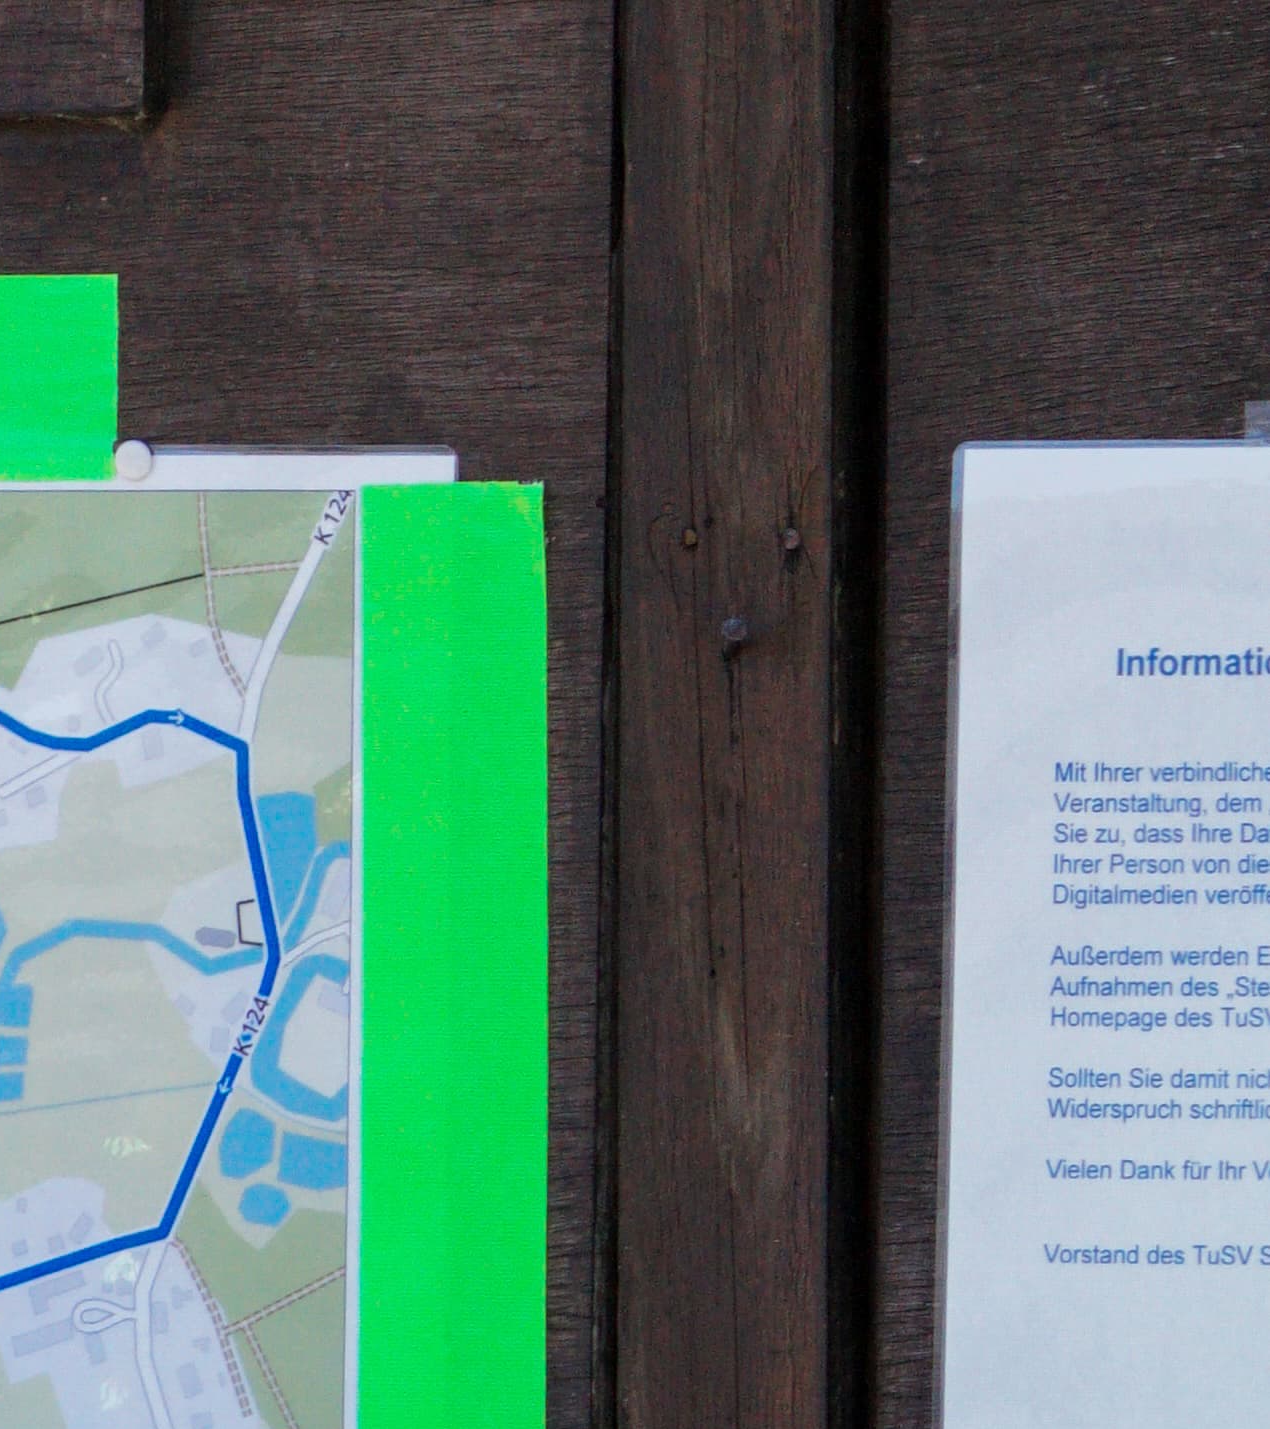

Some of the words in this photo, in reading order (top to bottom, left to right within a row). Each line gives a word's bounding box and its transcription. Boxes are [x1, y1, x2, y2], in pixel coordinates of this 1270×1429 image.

[313, 525, 334, 546] K
[1054, 762, 1087, 783] Mit
[1094, 762, 1142, 783] Ihrer
[1054, 792, 1208, 818] Veranstaltung,
[1216, 792, 1263, 813] dem
[1053, 823, 1088, 844] Sie
[1095, 828, 1126, 847] zu,
[1133, 823, 1184, 844] dass
[1191, 823, 1233, 844] Ihre
[1053, 853, 1102, 874] Ihrer
[1109, 853, 1185, 874] Person
[1192, 858, 1231, 874] von
[1053, 884, 1198, 908] Digitalmedien
[1205, 884, 1270, 905] veröff
[1050, 945, 1163, 966] Außerdem
[1171, 945, 1249, 966] werden
[1050, 976, 1173, 997] Aufnahmen
[1180, 976, 1219, 997] des
[242, 996, 271, 1033] 124
[1050, 1007, 1168, 1032] Homepage
[1174, 1007, 1213, 1027] des
[233, 1037, 253, 1057] K
[1048, 1067, 1122, 1089] Sollten
[1129, 1067, 1164, 1089] Sie
[1170, 1068, 1230, 1089] damit
[1236, 1068, 1270, 1089] nic
[1047, 1098, 1182, 1124] Widerspruch
[1046, 1159, 1113, 1180] Vielen
[1120, 1160, 1175, 1180] Dank
[1182, 1159, 1213, 1180] für
[1218, 1160, 1247, 1180] Ihr
[1044, 1244, 1139, 1265] Vorstand
[1146, 1244, 1186, 1265] des
[1192, 1245, 1254, 1265] TuSV
